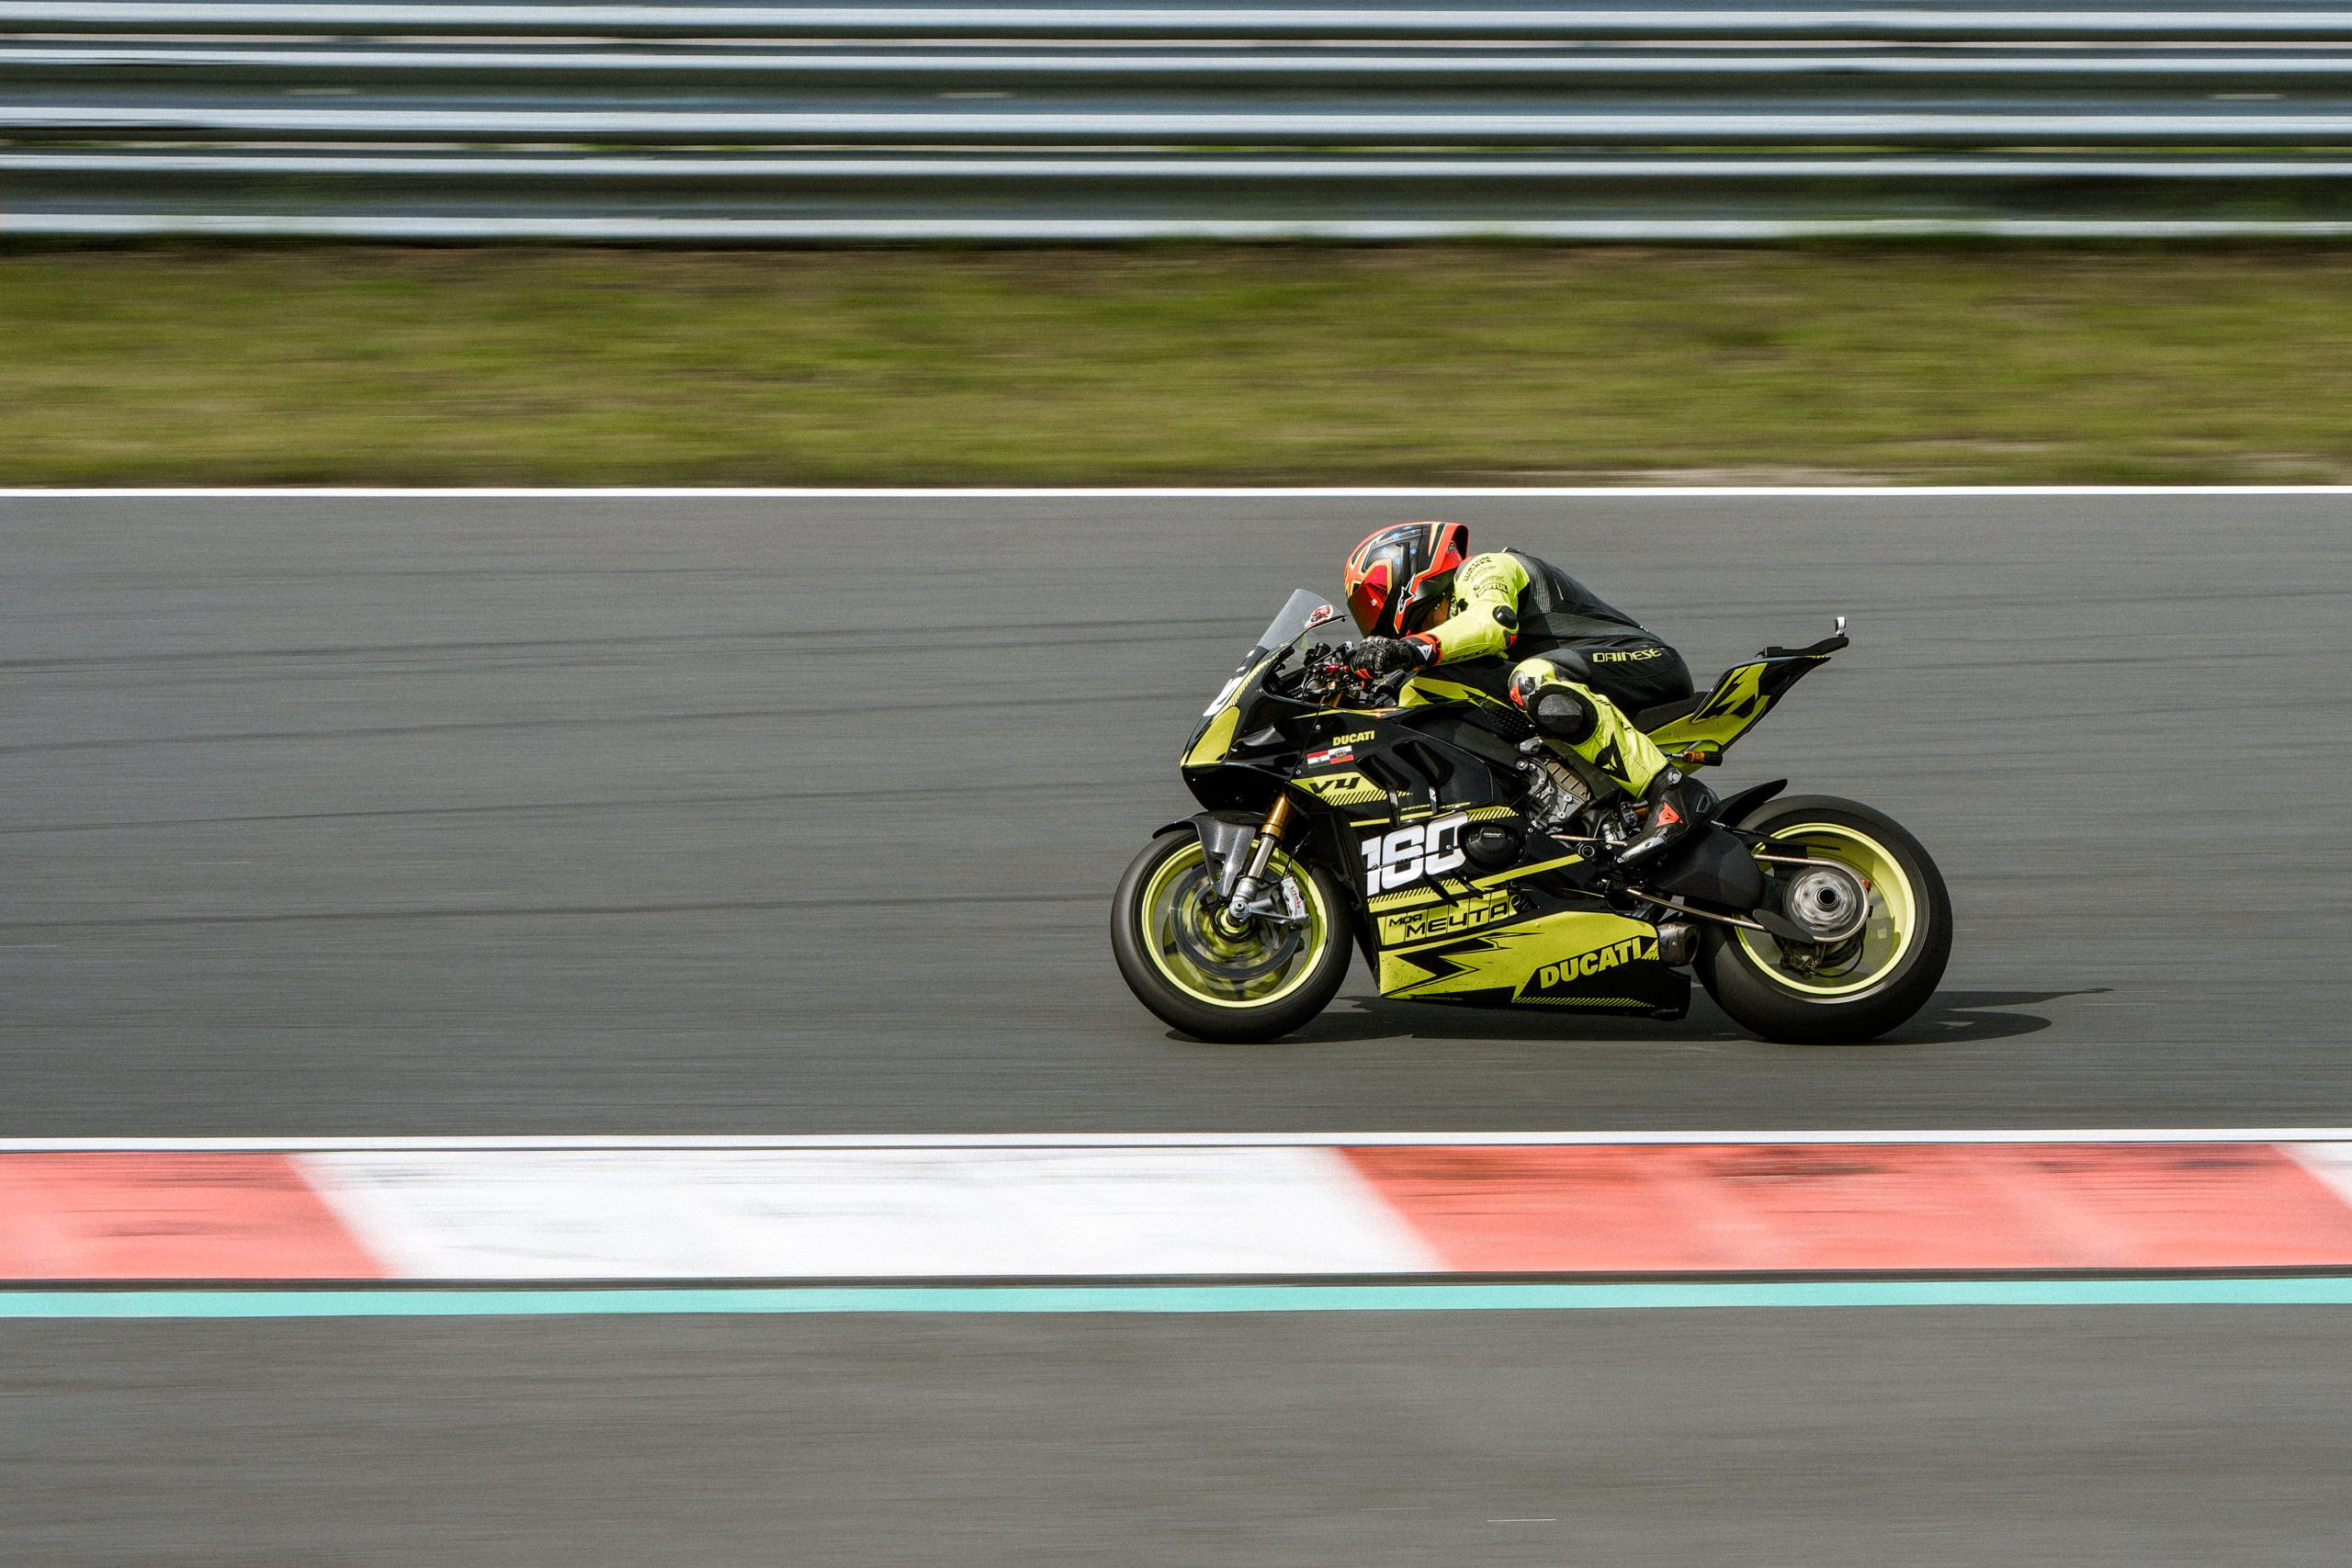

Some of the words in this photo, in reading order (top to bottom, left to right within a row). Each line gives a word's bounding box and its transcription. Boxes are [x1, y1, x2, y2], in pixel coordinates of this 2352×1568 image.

[1592, 649, 1662, 662] DAINESE
[1332, 730, 1375, 746] DUCATI
[1308, 776, 1361, 794] V4
[1362, 812, 1468, 897] 160
[1290, 886, 1301, 909] brembo
[1539, 937, 1642, 989] DUCATI
